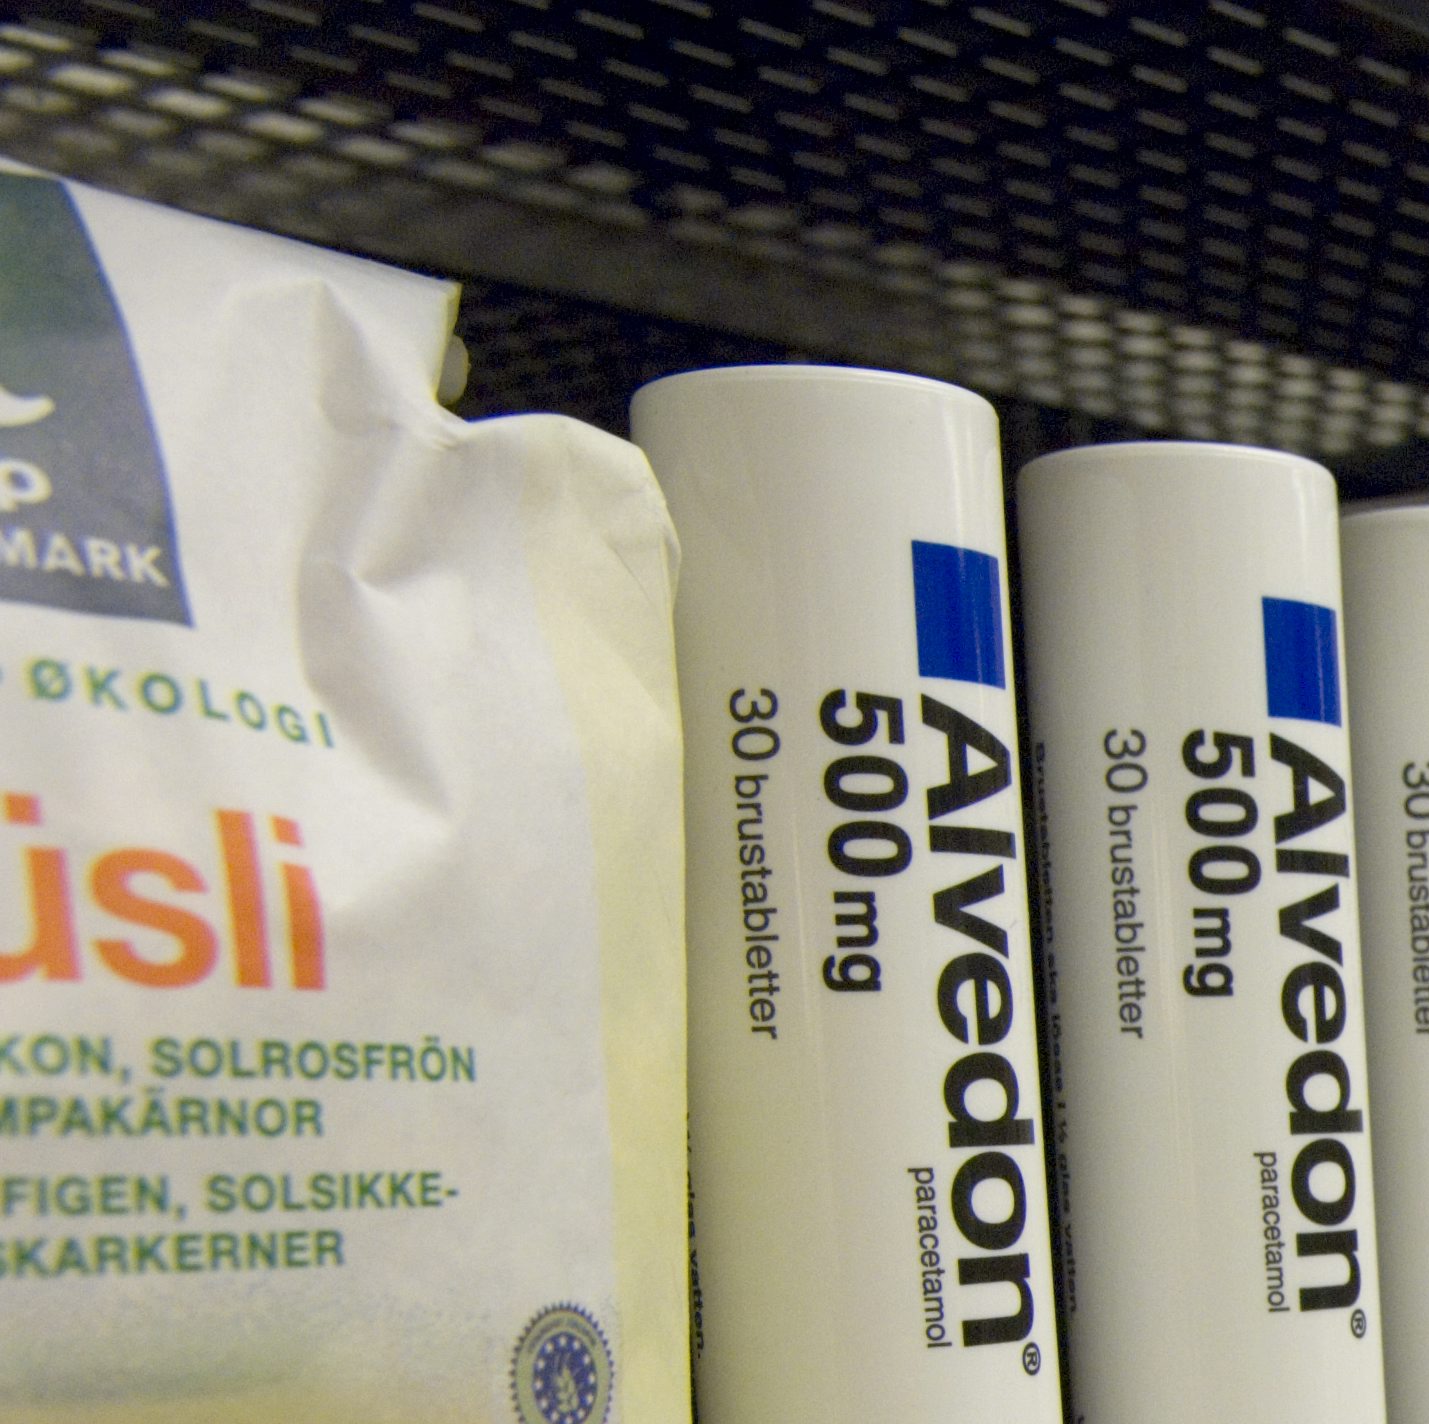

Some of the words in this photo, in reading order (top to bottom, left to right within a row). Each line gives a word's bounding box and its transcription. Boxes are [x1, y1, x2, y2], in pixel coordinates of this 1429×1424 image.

[29, 657, 335, 749] ØKOLOGI
[729, 688, 781, 761] 30
[819, 688, 913, 878] 500
[1103, 728, 1148, 794] 30
[1182, 729, 1262, 895] 500
[734, 774, 780, 1040] brustabletter
[822, 891, 882, 992] mg
[1107, 805, 1146, 1039] brustabletter
[1182, 908, 1234, 997] mg
[149, 1037, 477, 1083] SOLROSFRÖN
[0, 1174, 188, 1222] FIGEN,
[205, 1171, 459, 1214] SOLSIKKE-
[1254, 1152, 1290, 1313] paracetamol
[0, 1230, 346, 1280] KARKERNER
[908, 1167, 952, 1349] paracetamol
